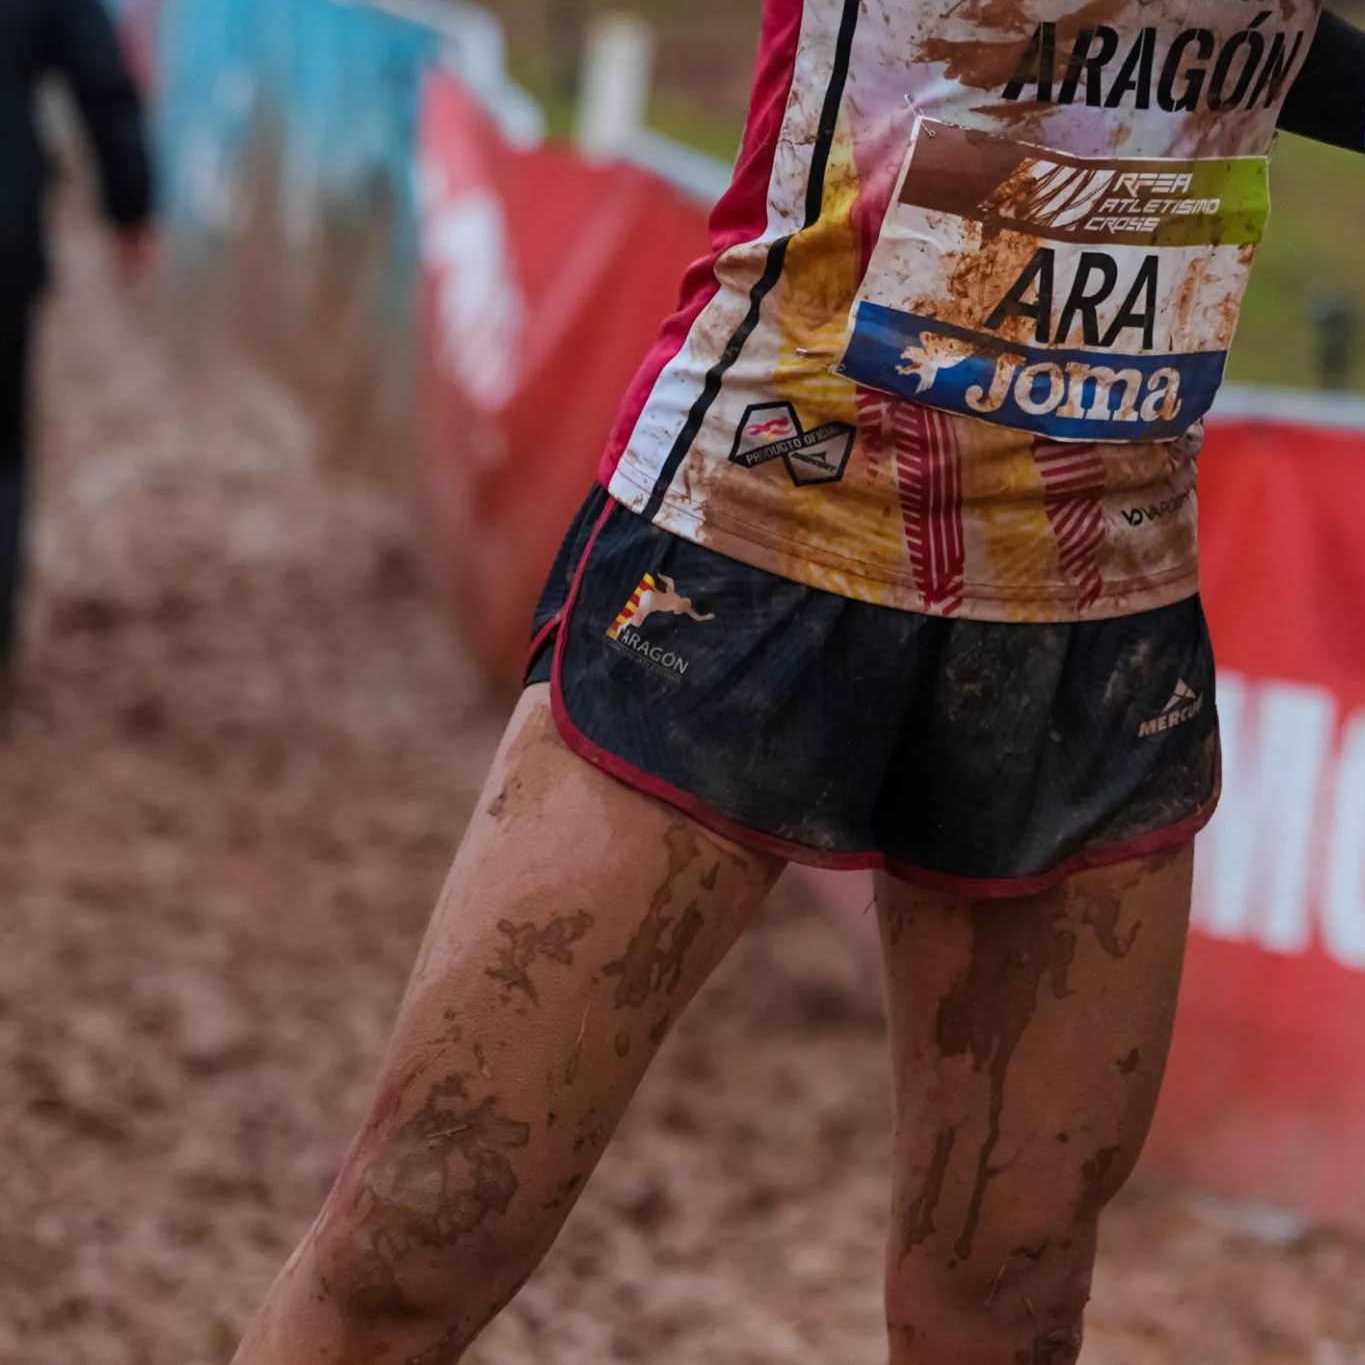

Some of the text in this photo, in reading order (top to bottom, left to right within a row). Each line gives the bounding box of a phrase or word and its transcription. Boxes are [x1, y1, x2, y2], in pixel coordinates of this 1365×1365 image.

[1001, 11, 1303, 113] ARAGÓN
[1112, 172, 1193, 198] RFEA
[1098, 198, 1221, 215] ATLETISMO
[1083, 216, 1160, 234] CROSS
[984, 247, 1160, 351] ARA
[619, 628, 689, 674] ARAGÓN
